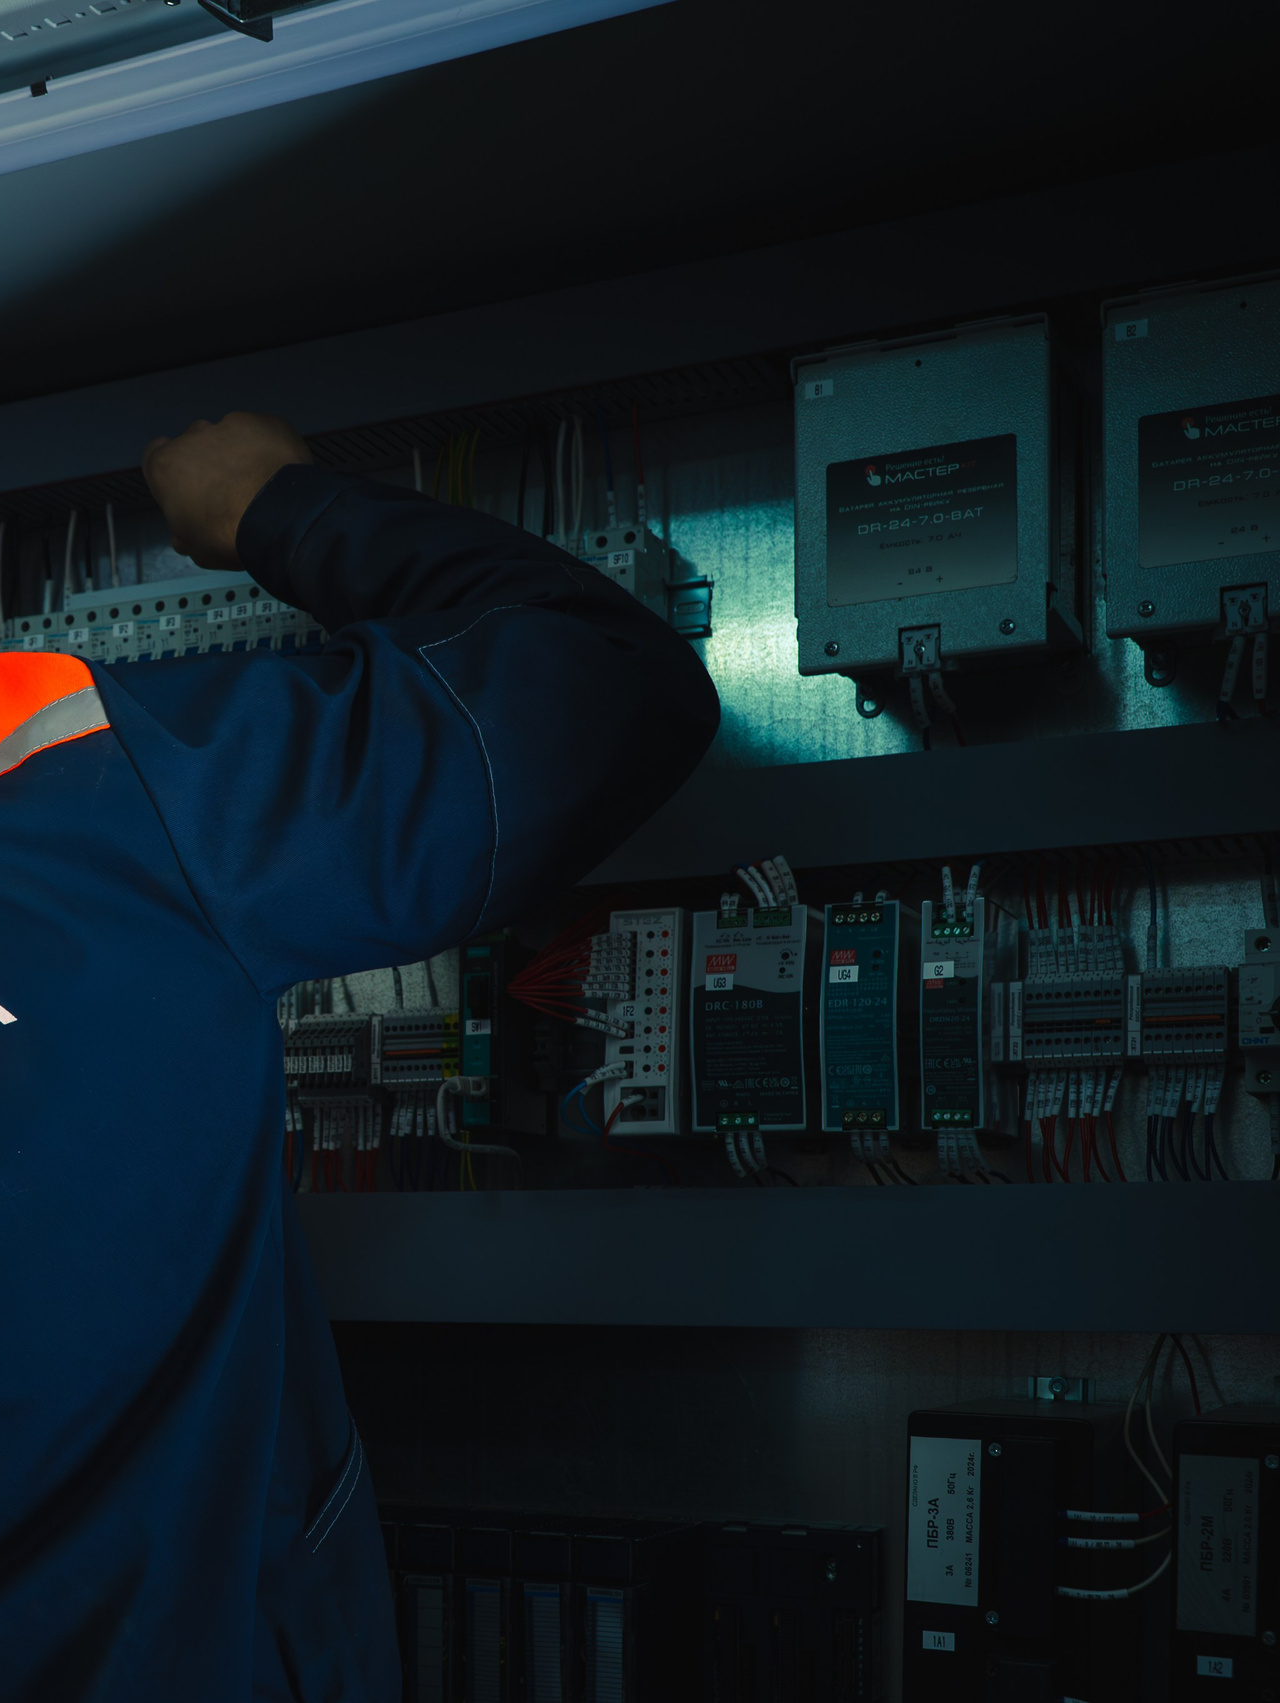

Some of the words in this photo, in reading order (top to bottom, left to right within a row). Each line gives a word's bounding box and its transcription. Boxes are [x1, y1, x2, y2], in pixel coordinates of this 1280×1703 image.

[1127, 325, 1136, 337] B2
[885, 463, 960, 485] МАСТЕР
[858, 506, 985, 535] DR-24-7.0-BAT
[708, 954, 736, 966] MW
[838, 969, 851, 980] UG4
[934, 965, 944, 976] G2
[713, 977, 726, 988] UG3
[705, 999, 764, 1011] DRC-180B
[1241, 1037, 1270, 1045] CHNT
[947, 1472, 957, 1495] 50Гц
[926, 1497, 939, 1549] ПБР-3А
[946, 1518, 955, 1541] 380В
[965, 1513, 974, 1544] МАССА
[1200, 1515, 1214, 1571] ПБР-2М
[1222, 1538, 1232, 1563] 220В
[946, 1564, 954, 1577] 3А
[1222, 1588, 1231, 1602] 4А
[932, 1635, 946, 1649] 1A1
[1208, 1660, 1223, 1674] 1A2
